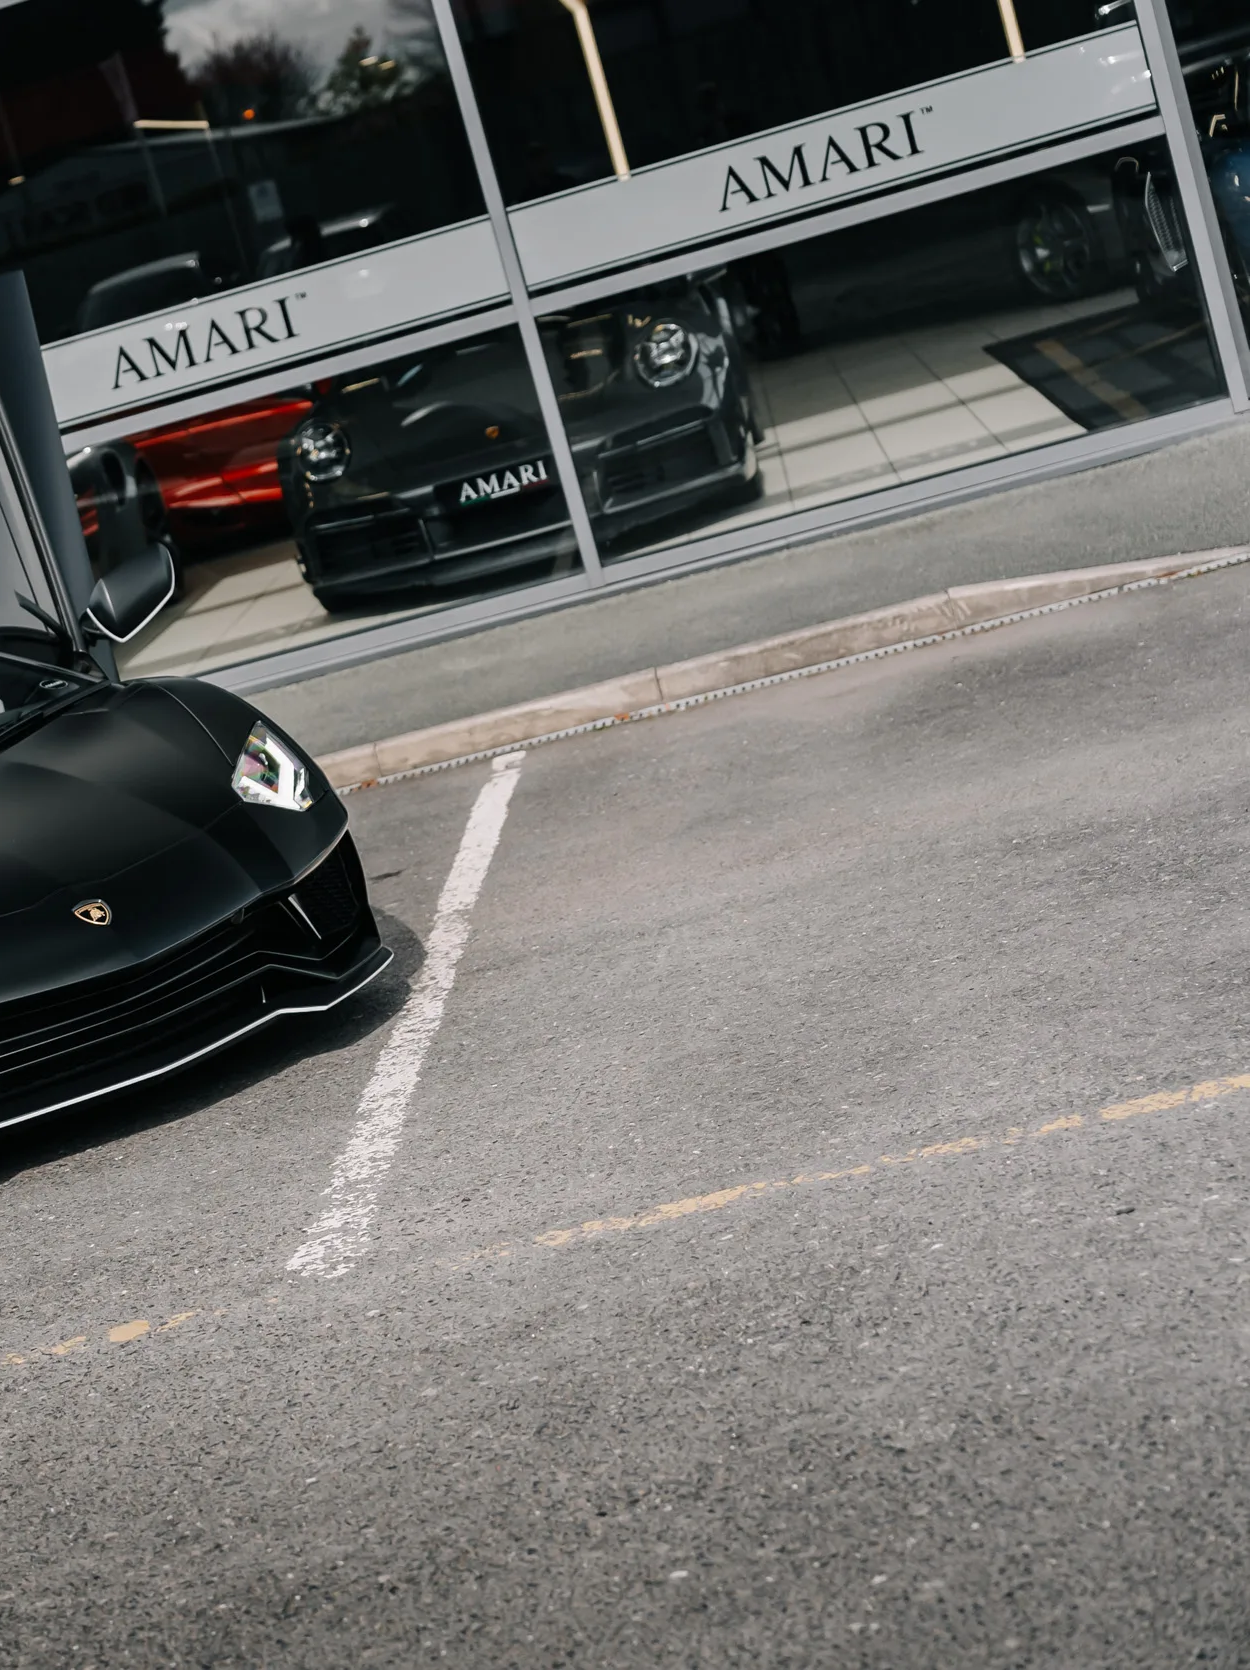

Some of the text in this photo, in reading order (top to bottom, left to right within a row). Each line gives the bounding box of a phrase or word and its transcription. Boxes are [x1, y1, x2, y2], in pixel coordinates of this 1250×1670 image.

[719, 110, 925, 213] AMARI
[112, 297, 299, 389] AMARI
[460, 460, 548, 503] AMARI
